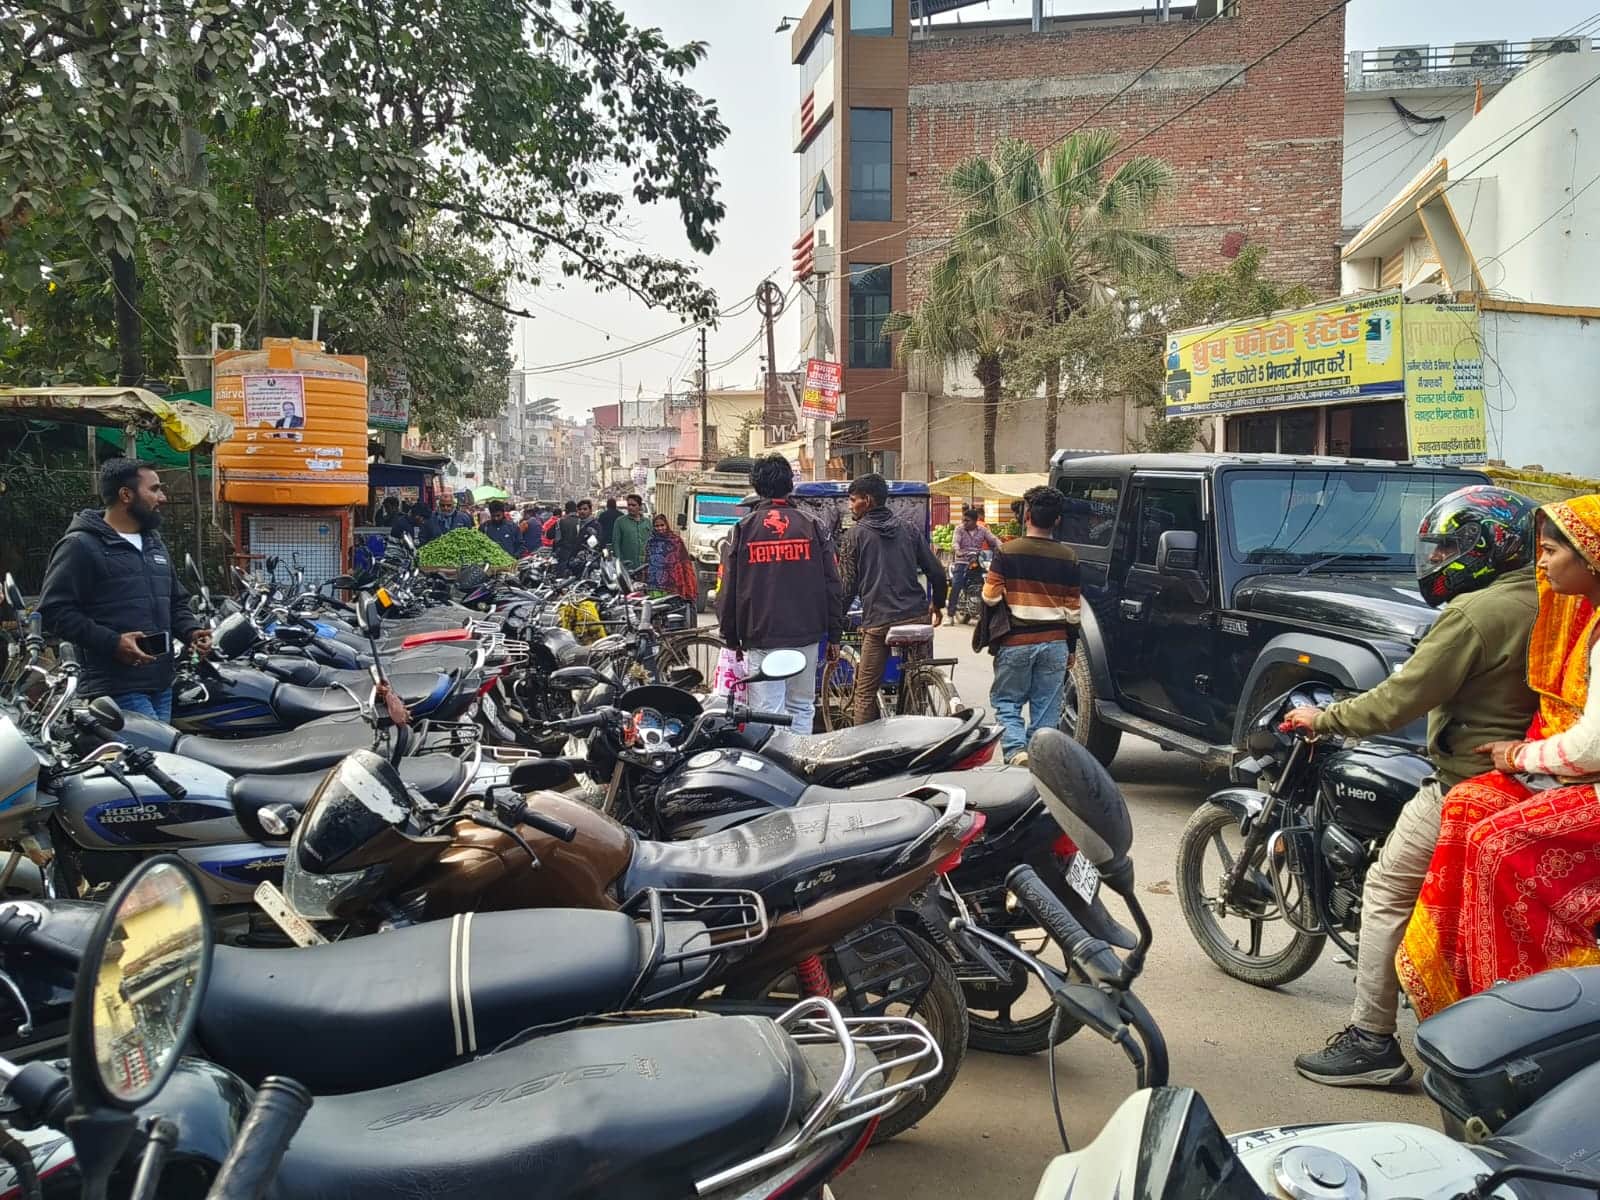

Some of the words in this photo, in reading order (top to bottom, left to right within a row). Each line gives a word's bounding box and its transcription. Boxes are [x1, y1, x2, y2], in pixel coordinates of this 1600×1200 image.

[1233, 321, 1298, 359] फोटो
[1303, 311, 1362, 349] स्टेट
[1237, 365, 1257, 384] फोटो
[1258, 365, 1265, 381] 5
[1266, 360, 1291, 381] मिनट
[1302, 357, 1326, 379] प्राप्त
[1326, 349, 1346, 375] करें
[747, 538, 811, 565] Ferrari
[1347, 787, 1377, 802] Hero
[100, 812, 166, 825] HONDA
[105, 804, 158, 816] HERO
